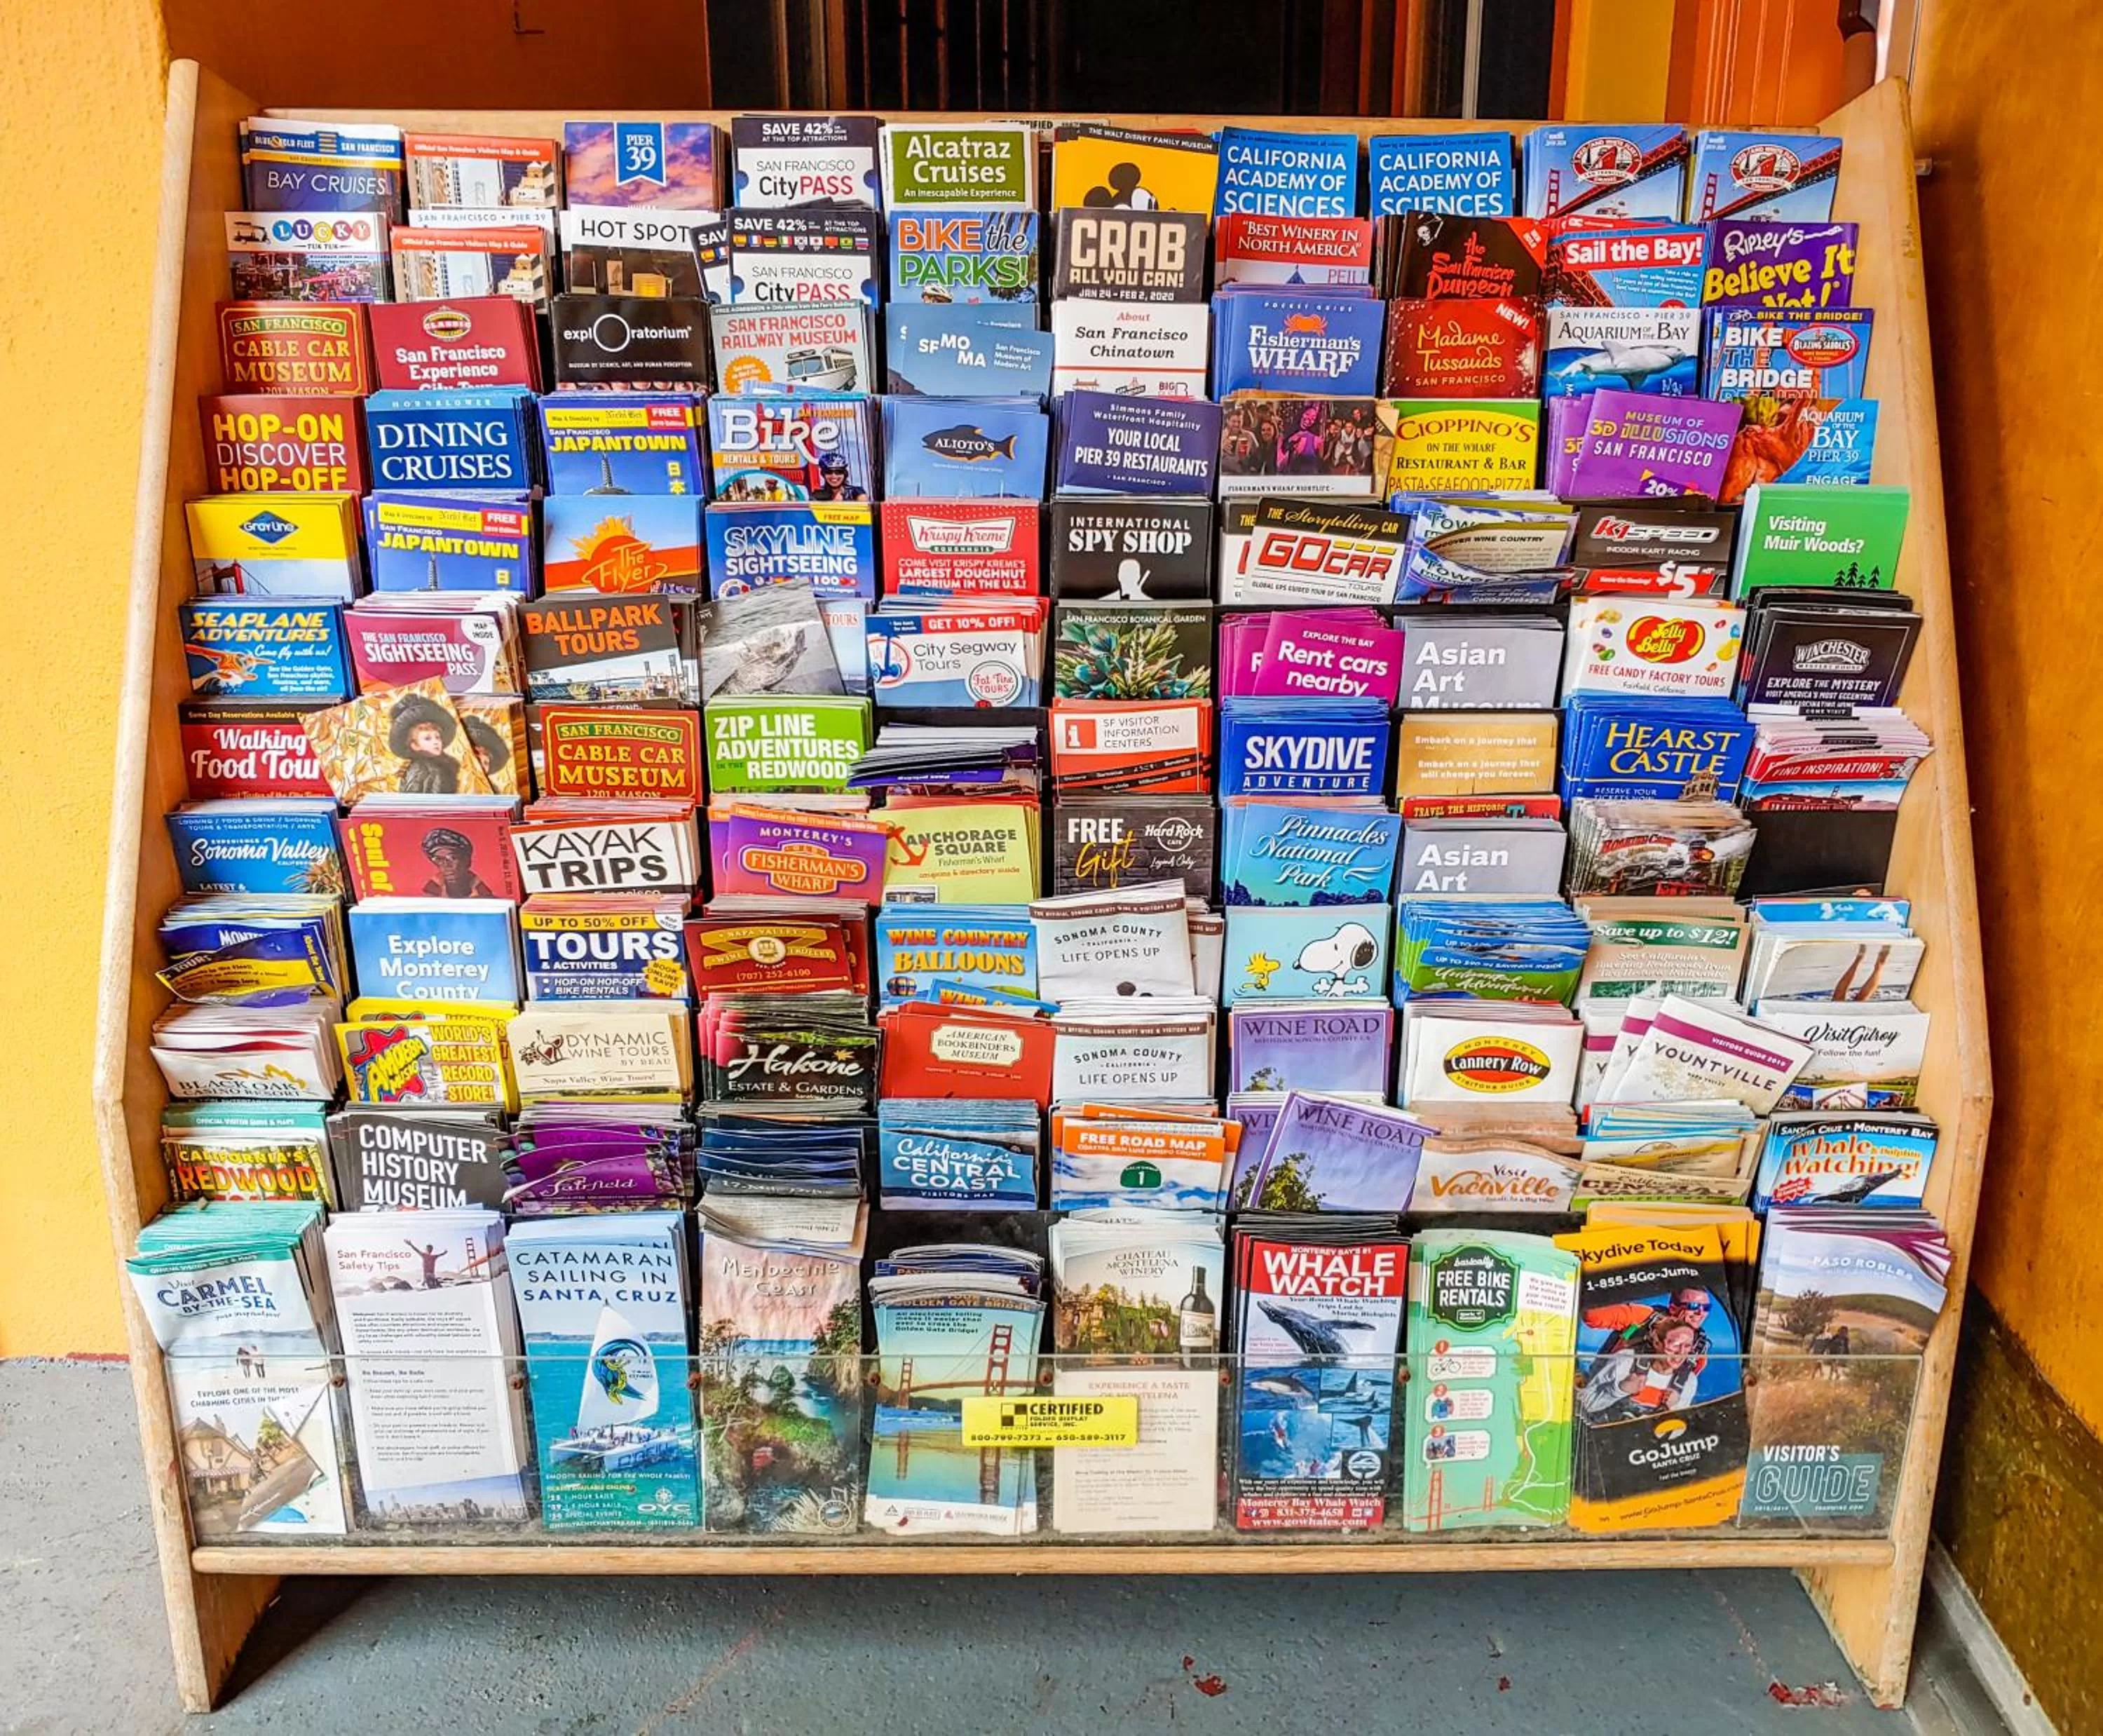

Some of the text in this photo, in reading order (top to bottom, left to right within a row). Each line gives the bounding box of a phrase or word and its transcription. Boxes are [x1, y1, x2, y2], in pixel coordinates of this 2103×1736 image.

[762, 123, 833, 135] SAVE 42%
[1089, 128, 1212, 150] THE WALT DISNEY FAMILY MUSEUM
[627, 135, 654, 146] PIER
[906, 135, 1010, 160] Alcatraz
[626, 146, 656, 171] 39
[1227, 146, 1346, 170] CALIFORNIA
[913, 161, 1006, 183] Cruises
[1225, 168, 1346, 191] ACADEMY OF
[268, 172, 386, 195] BAY CRUISES
[759, 175, 853, 198] CityPASS
[904, 188, 1016, 198] An Inescapable Experience
[1223, 191, 1345, 217] SCIENCES
[277, 221, 367, 240] LUCKY
[898, 219, 1027, 252] BIKE the
[1070, 219, 1187, 271] CRAB
[1567, 238, 1703, 264] Sail the Bay!
[899, 255, 1029, 287] PARKS!
[1070, 270, 1183, 288] ALL YOU CAN!
[1704, 259, 1811, 302] Believe
[1820, 244, 1854, 278] It
[1080, 290, 1097, 299] JAN
[1098, 290, 1111, 299] 24
[1152, 292, 1173, 301] 2020
[1495, 302, 1530, 330] NEW!
[1757, 311, 1862, 321] BIKE THE BRIDGE!
[721, 330, 857, 350] RAILWAY MUSEUM
[1248, 325, 1360, 351] Fisherman's
[1417, 322, 1503, 349] Madame
[233, 341, 350, 357] CABLE CAR
[1090, 346, 1175, 359] Chinatown
[1417, 346, 1502, 372] Tussauds
[235, 362, 352, 383] MUSEUM
[1248, 348, 1359, 377] WHARF
[214, 414, 343, 442] HOP-ON
[377, 422, 508, 450] DINING
[1396, 419, 1535, 443] CIOPPINO'S
[1813, 427, 1859, 449] BAY
[548, 435, 686, 452] JAPANTOWN
[934, 438, 995, 451] ALIOTO'S
[1593, 440, 1713, 467] SAN FRANCISCO
[217, 444, 346, 467] DISCOVER
[1075, 447, 1208, 477] PIER 39 RESTAURANTS
[1396, 457, 1526, 470] RESTAURANT & BAR
[219, 467, 347, 491] HOP-OFF
[382, 455, 512, 481] CRUISES
[1070, 517, 1191, 530] INTERNATIONAL
[1768, 515, 1826, 536] Visiting
[724, 527, 856, 556] SKYLINE
[1068, 531, 1192, 555] SPY SHOP
[1764, 536, 1865, 554] Muir Woods?
[726, 555, 857, 576] SIGHTSEEING
[190, 613, 327, 628] SEAPLANE
[526, 604, 662, 636] BALLPARK
[189, 629, 329, 642] ADVENTURES
[554, 631, 640, 656] TOURS
[913, 642, 1016, 658] City Segway
[1278, 641, 1388, 677] Rent cars
[1415, 642, 1506, 665] Asian
[915, 658, 961, 671] Tours
[1413, 670, 1466, 693] Art
[1589, 664, 1726, 688] FREE CANDY FACTORY TOURS
[714, 714, 816, 738] ZIP LINE
[214, 728, 307, 759] Walking
[1605, 723, 1741, 752] HEARST
[716, 739, 859, 760] ADVENTURES
[1244, 735, 1375, 770] SKYDIVE
[191, 750, 257, 780] Food
[1609, 749, 1729, 775] CASTLE
[1801, 761, 1883, 775] INSPIRATION!
[1243, 776, 1370, 789] ADVENTURE
[906, 829, 1016, 845] ANCHORAGE
[1068, 818, 1124, 843] FREE
[1276, 815, 1389, 845] Pinnacles
[191, 837, 329, 866] Sonoma Valley
[519, 827, 662, 861] KAYAK
[934, 842, 1006, 855] SQUARE
[1250, 834, 1366, 865] National
[526, 855, 667, 890] TRIPS
[1275, 864, 1331, 888] Park
[534, 916, 648, 928] UP TO 50% OFF
[388, 935, 474, 956] Explore
[529, 932, 680, 960] TOURS
[379, 958, 489, 980] Monterey
[892, 953, 1025, 975] BALLOONS
[429, 1026, 491, 1043] WORLD'S
[566, 1031, 667, 1047] DYNAMIC
[432, 1045, 496, 1062] GREATEST
[937, 1040, 1016, 1052] BOOKBINDERS
[728, 1044, 864, 1079] Hakone
[1450, 1055, 1542, 1073] Cannery Row
[1654, 1042, 1777, 1092] YOUNTVILLE
[442, 1065, 494, 1082] RECORD
[449, 1085, 495, 1101] STORE!
[728, 1081, 864, 1095] ESTATE & GARDENS
[1080, 1133, 1206, 1150] FREE ROAD MAP
[1853, 1123, 1933, 1139] MONTEREY BAY
[359, 1123, 488, 1164] COMPUTER
[177, 1165, 318, 1193] REDWOOD
[362, 1151, 458, 1186] HISTORY
[892, 1157, 1021, 1179] CENTRAL
[910, 1174, 1002, 1190] COAST
[337, 1249, 411, 1259] San Francisco
[517, 1251, 672, 1268] CATAMARAN
[1647, 1240, 1704, 1259] Today
[339, 1261, 400, 1270] Safety Tips
[722, 1256, 841, 1276] MENDOCINO
[1263, 1250, 1396, 1277] WHALE
[527, 1269, 667, 1284] SAILING IN
[1270, 1275, 1387, 1297] WATCH
[1436, 1271, 1510, 1289] FREE BIKE
[158, 1275, 273, 1306] CARMEL
[1440, 1289, 1506, 1307] RENTALS
[1030, 1402, 1103, 1416] CERTIFIED
[1629, 1435, 1719, 1465] GoJump
[1762, 1446, 1840, 1463] VISITOR'S
[1756, 1465, 1875, 1502] GUIDE
[1252, 1518, 1368, 1527] www.gowhales.com
